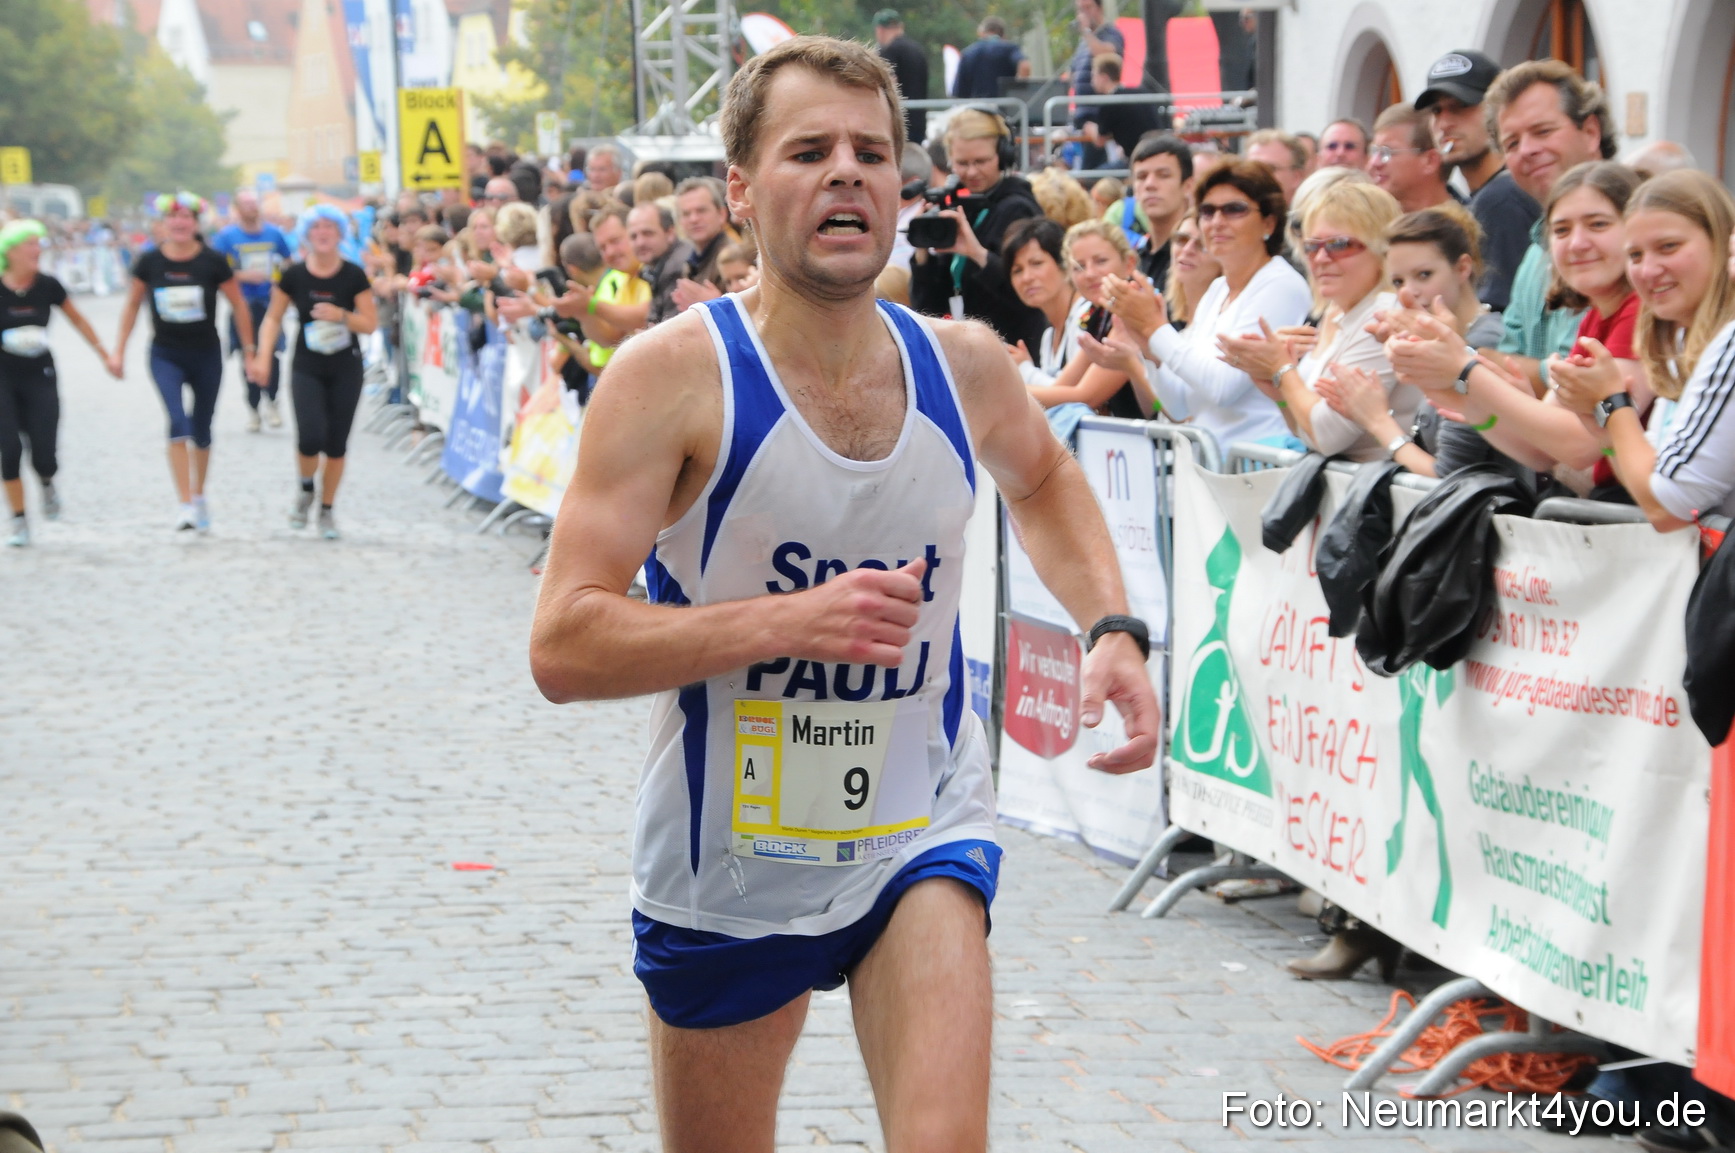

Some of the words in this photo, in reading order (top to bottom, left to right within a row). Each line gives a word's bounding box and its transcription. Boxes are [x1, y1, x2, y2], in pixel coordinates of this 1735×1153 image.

[404, 91, 457, 109] Block
[417, 119, 452, 164] A
[792, 714, 874, 746] Martin
[1267, 694, 1379, 790] EINFACH
[744, 757, 755, 780] A
[843, 766, 870, 811] 9
[754, 839, 807, 854] BOCK
[858, 828, 926, 852] PFLEIDERE
